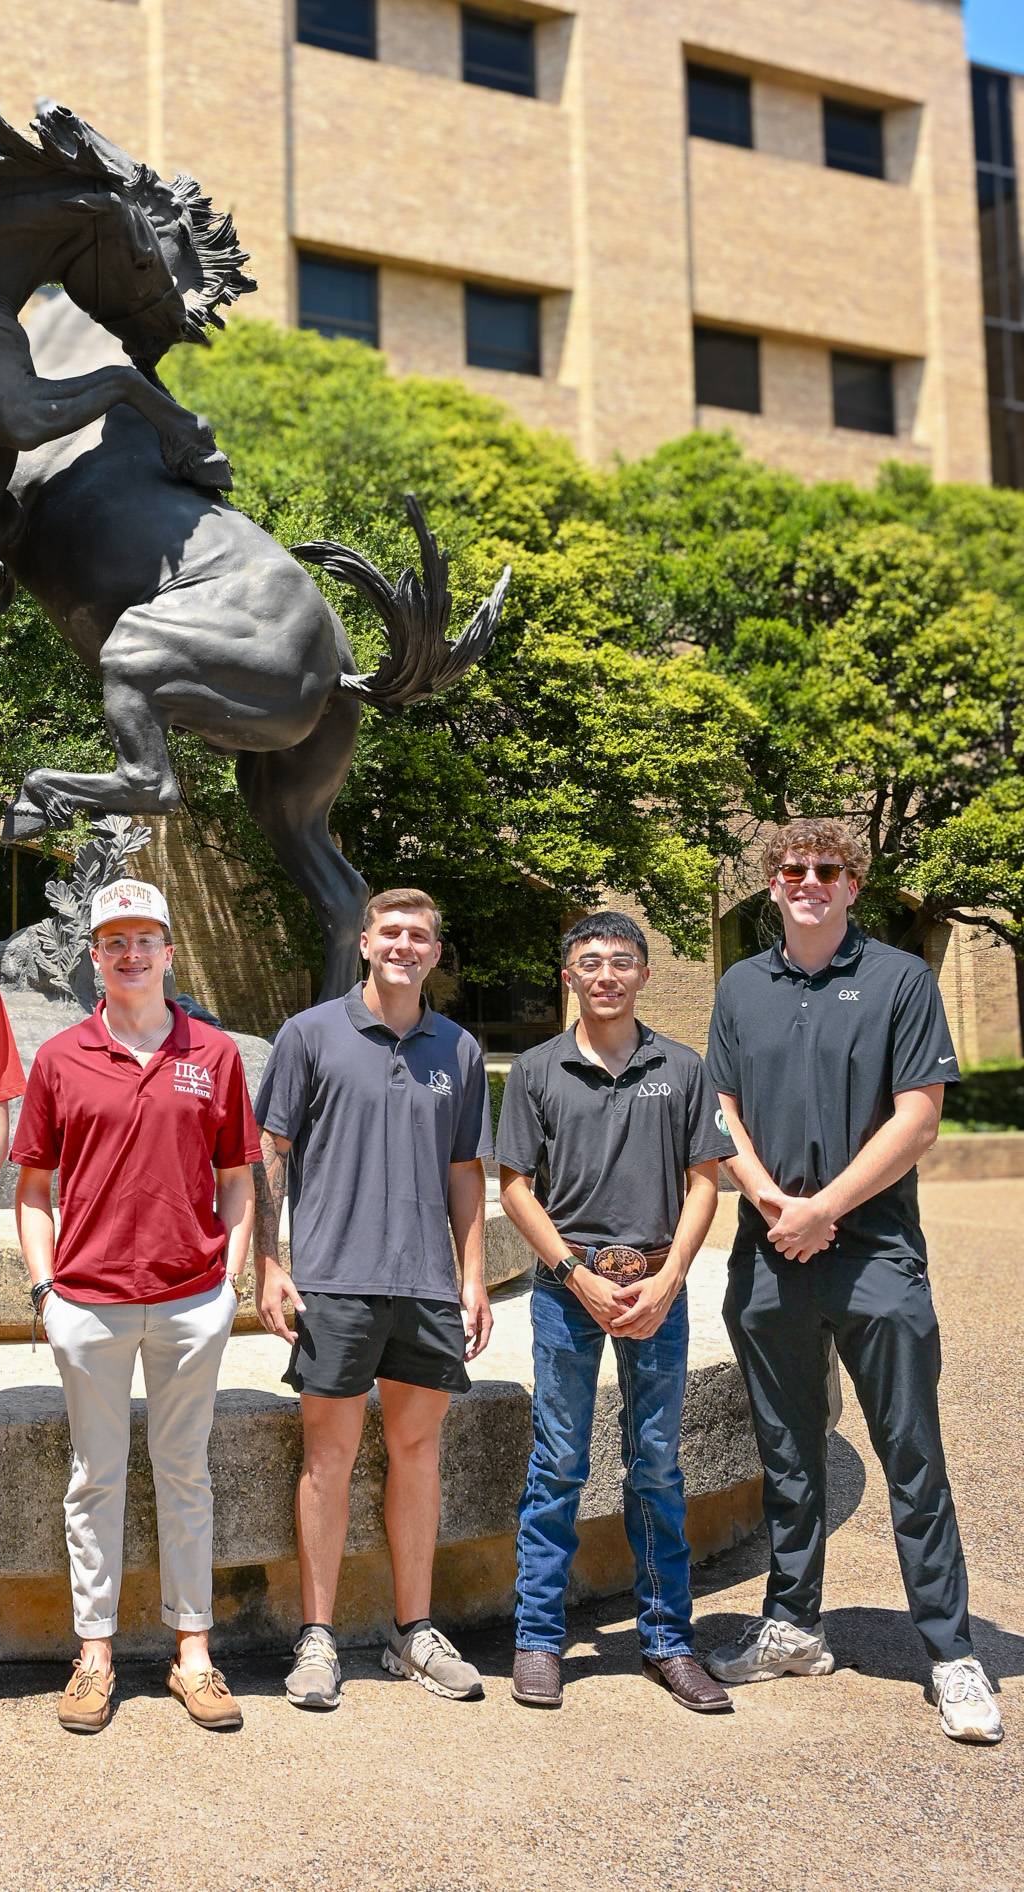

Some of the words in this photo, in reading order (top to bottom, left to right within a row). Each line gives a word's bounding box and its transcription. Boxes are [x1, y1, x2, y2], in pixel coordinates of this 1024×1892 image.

[99, 885, 125, 908] TEXAS
[125, 884, 152, 904] STATE
[173, 1084, 194, 1094] TEXAS
